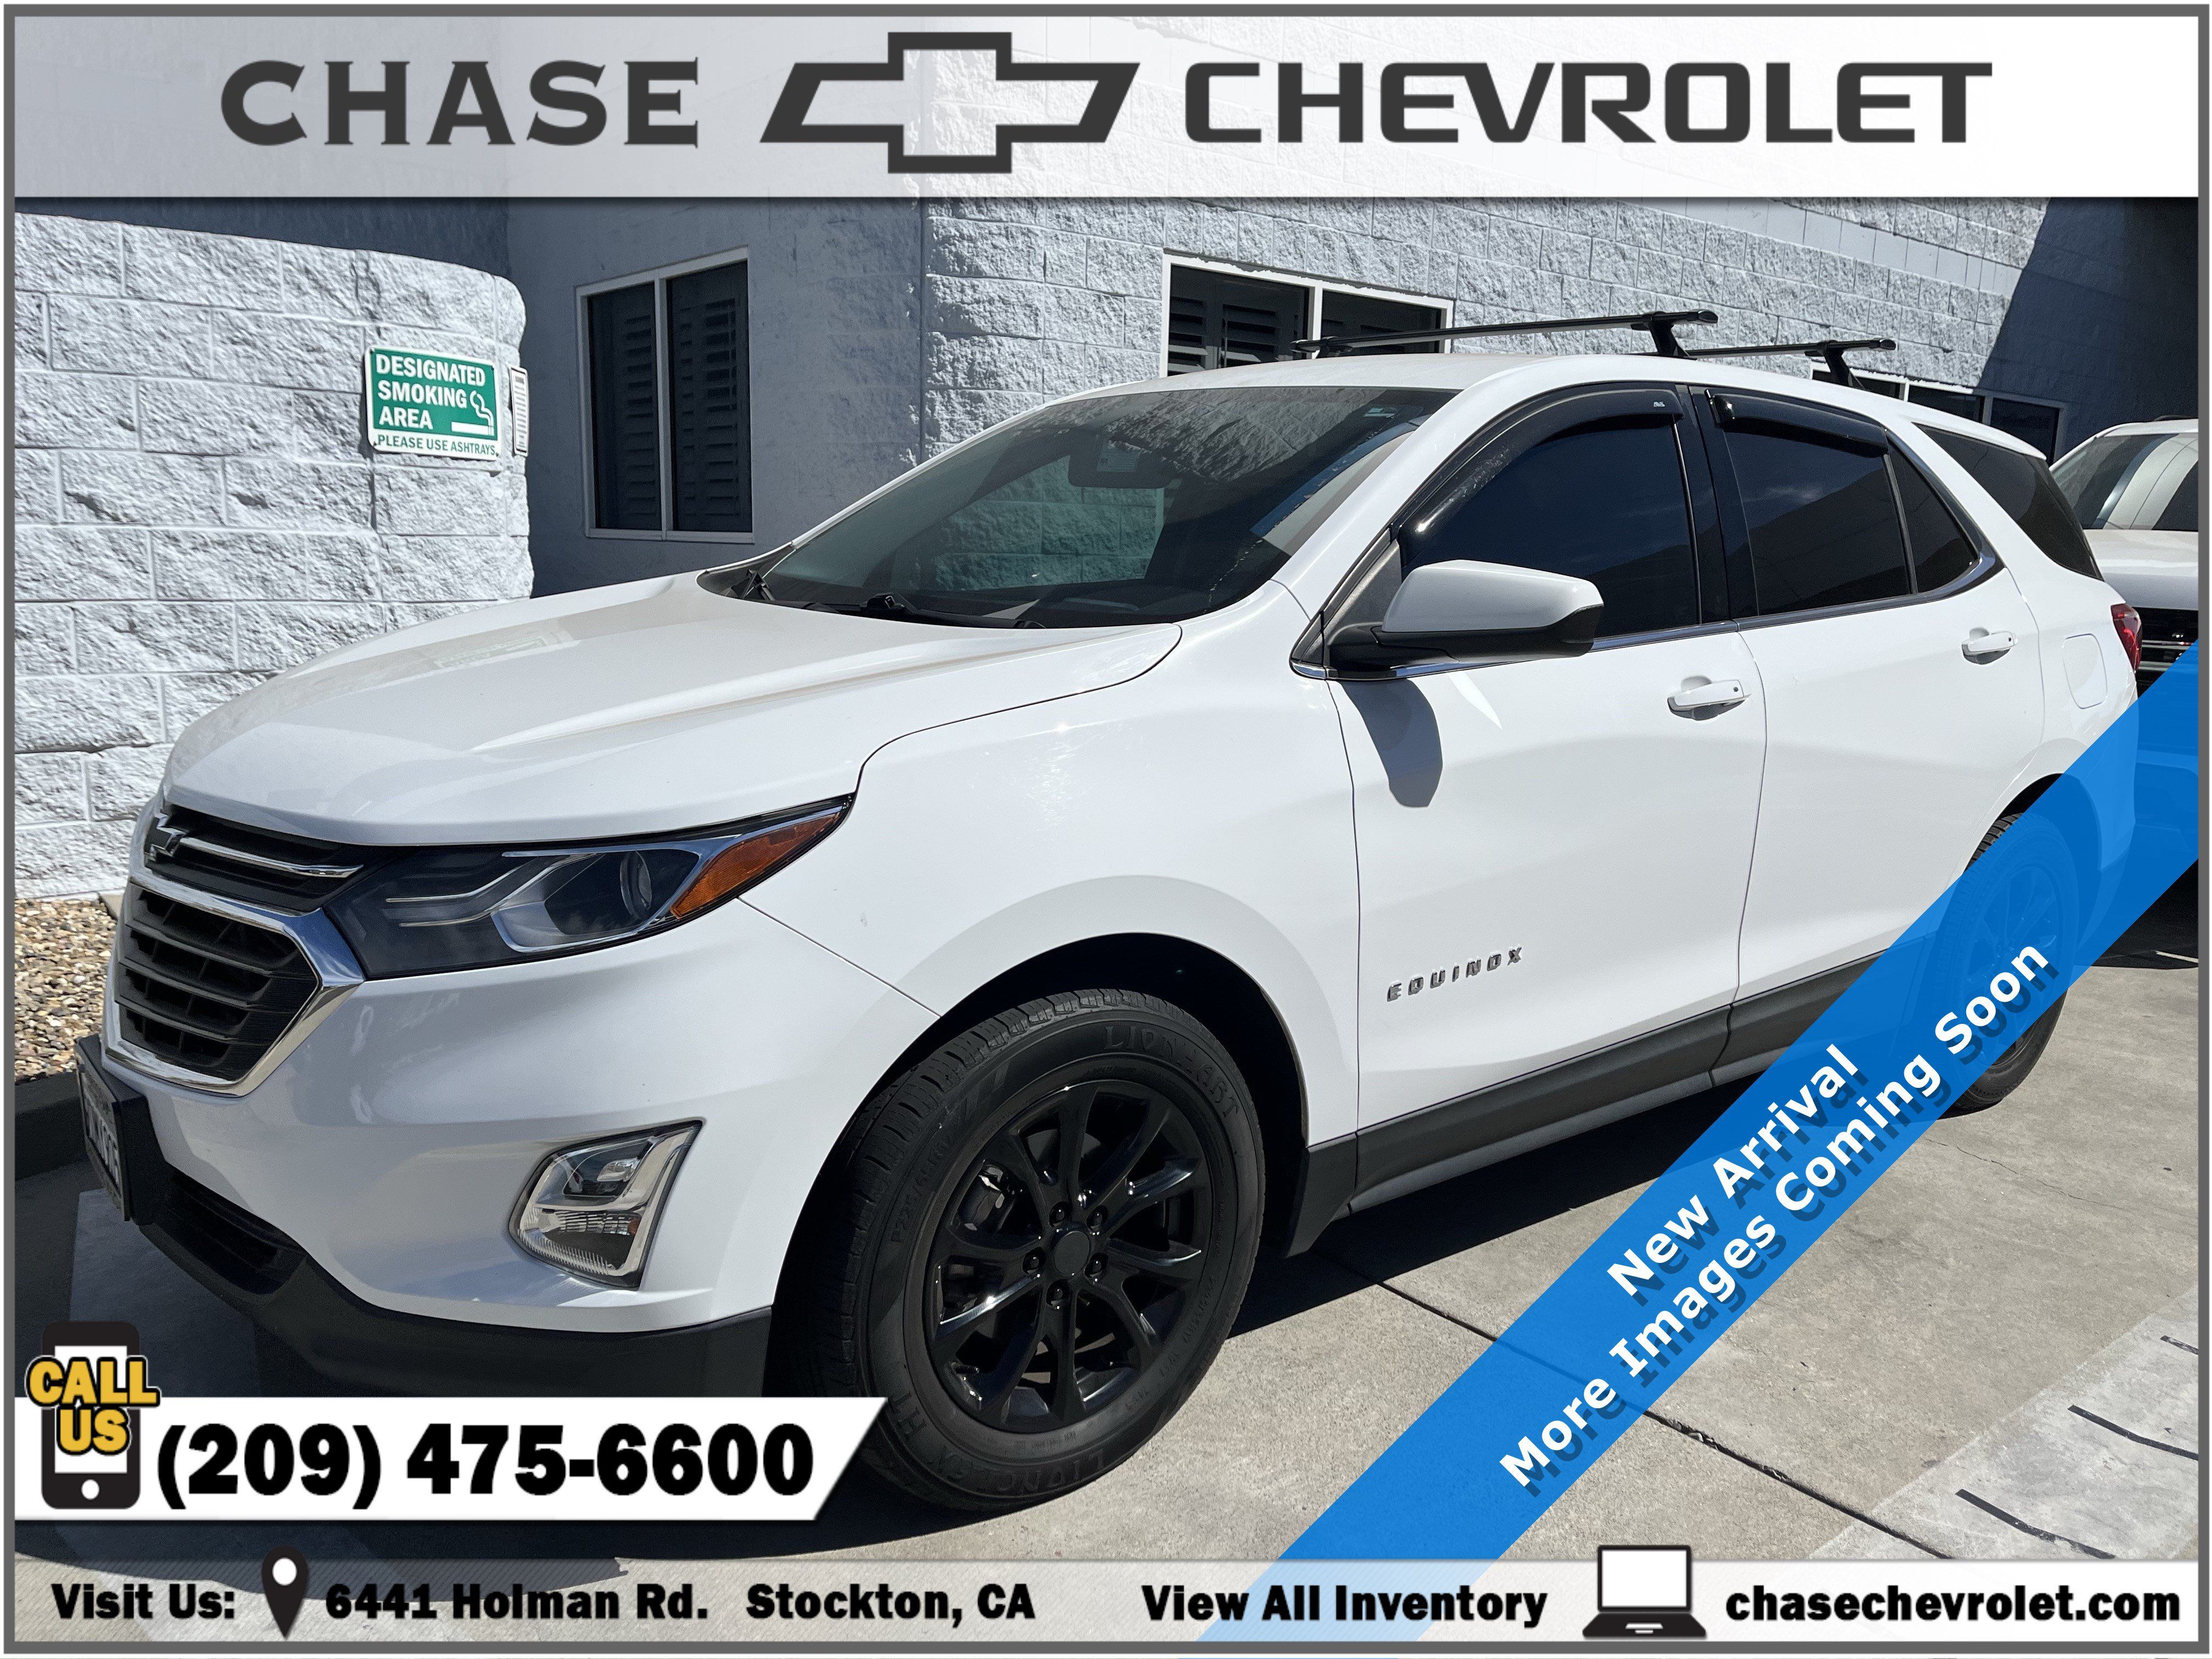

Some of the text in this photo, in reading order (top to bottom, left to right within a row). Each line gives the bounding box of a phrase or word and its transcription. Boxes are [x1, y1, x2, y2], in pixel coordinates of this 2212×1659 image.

[375, 353, 486, 387] DESIGNATED
[377, 380, 467, 408] SMOKING
[379, 405, 433, 430] AREA
[377, 434, 495, 455] PLEASE USE ASHTRAYS
[1386, 944, 1522, 1002] EQUINOX
